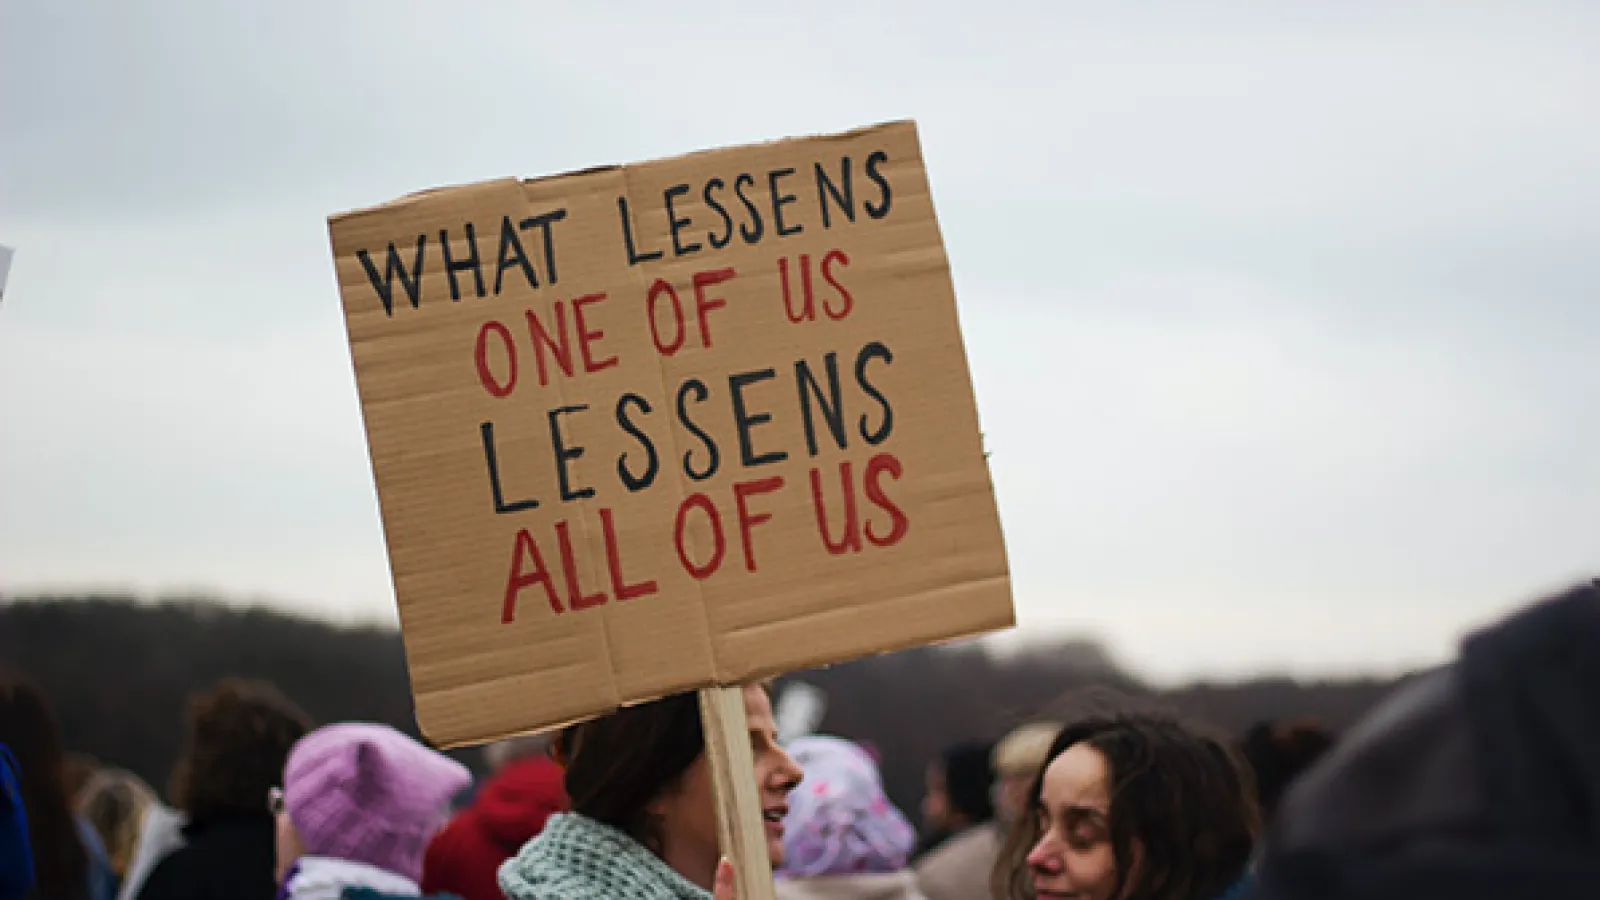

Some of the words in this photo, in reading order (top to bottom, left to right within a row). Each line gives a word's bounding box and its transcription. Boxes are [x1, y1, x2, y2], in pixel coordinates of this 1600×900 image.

[356, 208, 567, 317] WHAT
[618, 151, 893, 266] LESSENS
[474, 292, 619, 397] ONE
[646, 267, 736, 357] OF
[778, 249, 854, 323] US
[480, 341, 894, 514] LESSENS
[501, 508, 658, 624] ALL
[674, 475, 784, 579] OF
[809, 453, 908, 555] US
